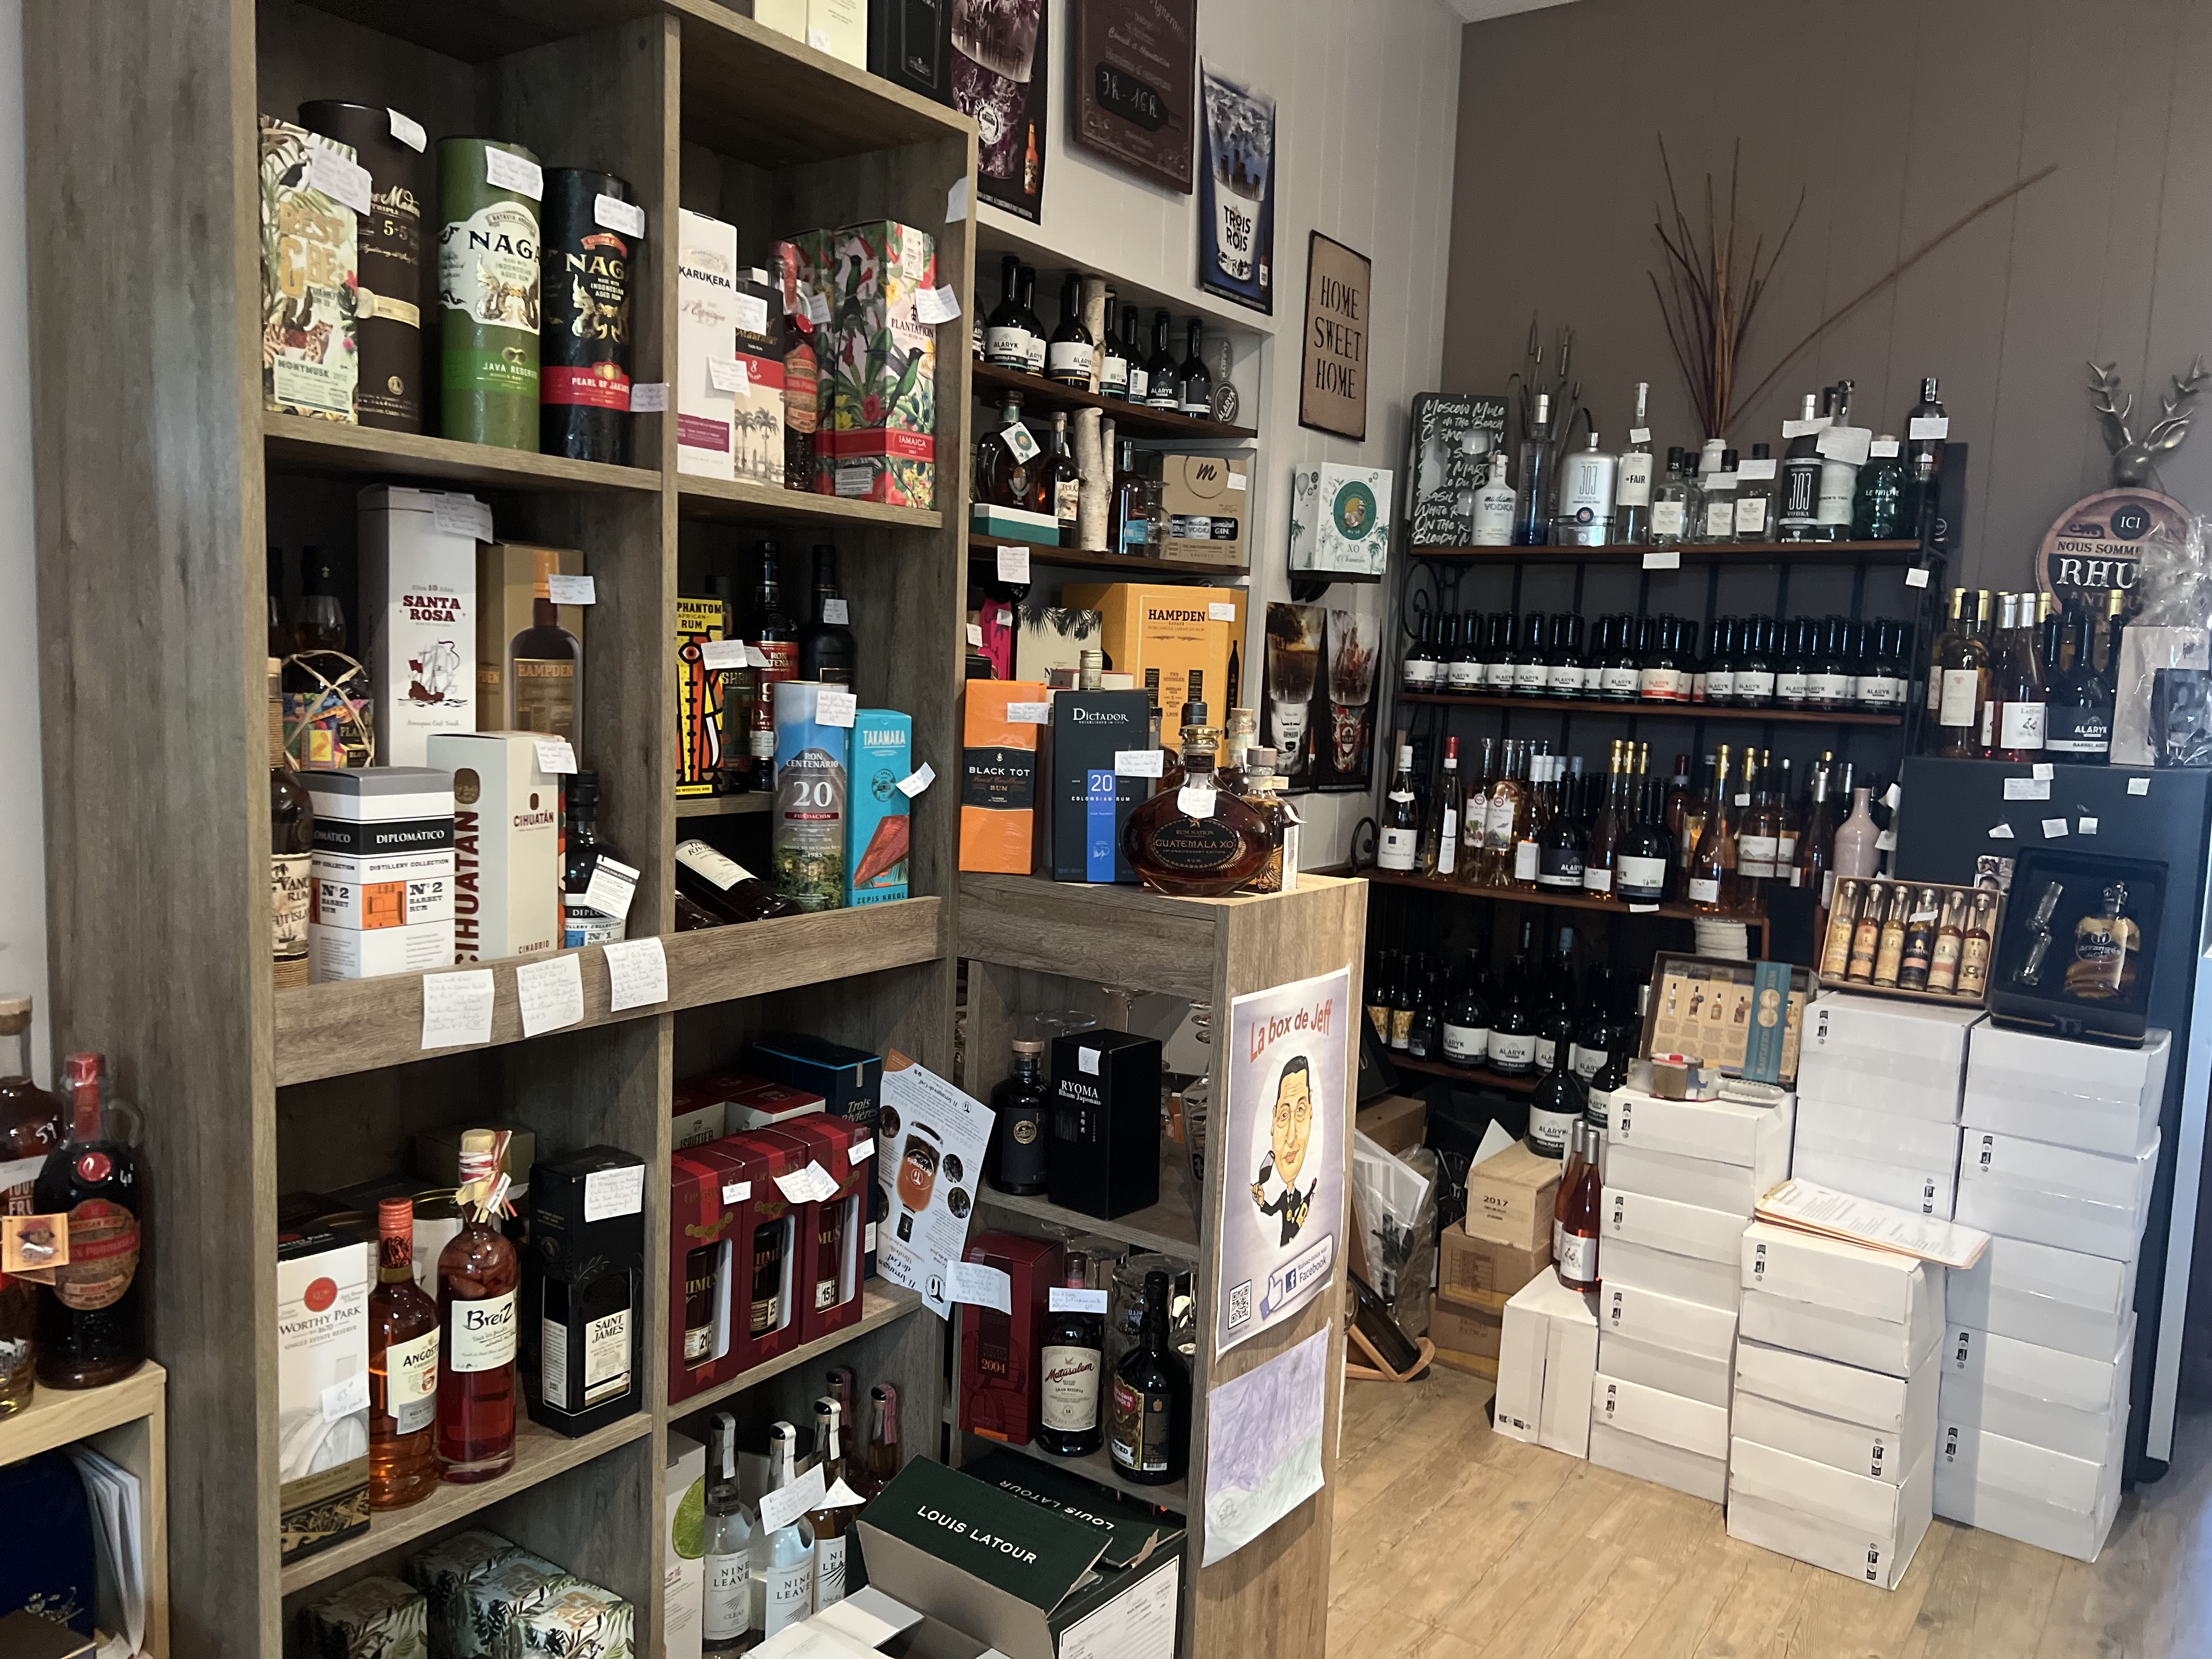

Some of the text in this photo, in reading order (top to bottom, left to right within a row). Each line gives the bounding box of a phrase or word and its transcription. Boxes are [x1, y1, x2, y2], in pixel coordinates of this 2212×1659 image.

[1224, 205, 1251, 234] TROIS
[1226, 227, 1248, 252] ROIS
[679, 266, 731, 289] KARUKERA
[1320, 275, 1360, 321] HOME
[891, 317, 934, 338] PLANTATION
[1314, 316, 1362, 362] SWEET
[1029, 352, 1043, 360] ARYK
[482, 362, 507, 373] JAVA
[572, 377, 596, 387] PEARL
[1316, 358, 1357, 399] HOME
[1217, 390, 1235, 421] ALARYK
[899, 435, 927, 448] JAMAICA
[1629, 475, 1645, 484] FAIR
[1788, 472, 1811, 510] 303
[1484, 503, 1514, 512] VODKA
[2121, 516, 2141, 529] ICI
[1347, 544, 1360, 554] XO
[2057, 541, 2092, 553] NOUS
[2056, 558, 2141, 589] RHU
[403, 595, 461, 610] SANTA
[676, 602, 723, 615] PHANTOM
[410, 608, 456, 623] ROSA
[1148, 609, 1206, 622] HAMPDEN
[681, 619, 702, 630] RUM
[517, 664, 572, 677] HAMPDEN
[2074, 725, 2107, 734] ALARYK
[863, 730, 906, 746] TAKAMAKA
[786, 760, 839, 769] CENTENARIO
[804, 752, 823, 761] RON
[969, 766, 1030, 777] BLACK TOT
[1091, 774, 1113, 792] 20
[793, 781, 833, 808] 20
[514, 809, 554, 827] CIHUATÁN
[376, 830, 445, 844] DIPLOMÁTICO
[1155, 839, 1234, 849] GUATEMALA XO
[369, 859, 449, 871] DISTILLERY COLLECTION
[856, 891, 905, 905] ZEPIS KREOL
[572, 908, 601, 917] DIPLO
[518, 940, 550, 954] CINABRIO
[1250, 997, 1333, 1063] La box de Jeff
[1059, 1088, 1101, 1105] Rhum Japonais
[1062, 1080, 1098, 1098] RYOMA
[848, 1097, 872, 1114] Trois
[1483, 1195, 1509, 1207] 2017
[1300, 1255, 1327, 1284] Facebook
[822, 1286, 830, 1302] 15
[279, 1306, 362, 1335] WORTHY PARK
[595, 1314, 624, 1333] SAINT
[592, 1323, 624, 1344] JAMES
[699, 1333, 708, 1350] 21
[403, 1346, 439, 1368] ANGOS
[981, 1358, 1006, 1374] 2004
[1045, 1362, 1096, 1383] Matusalem
[998, 1480, 1115, 1531] LOUIS LATOUR
[916, 1505, 1037, 1565] LOUIS LATOUR
[830, 1550, 843, 1560] NI
[721, 1560, 750, 1577] NINE
[823, 1561, 845, 1571] LEA
[784, 1571, 811, 1589] NINE
[777, 1579, 812, 1600] LEAVE
